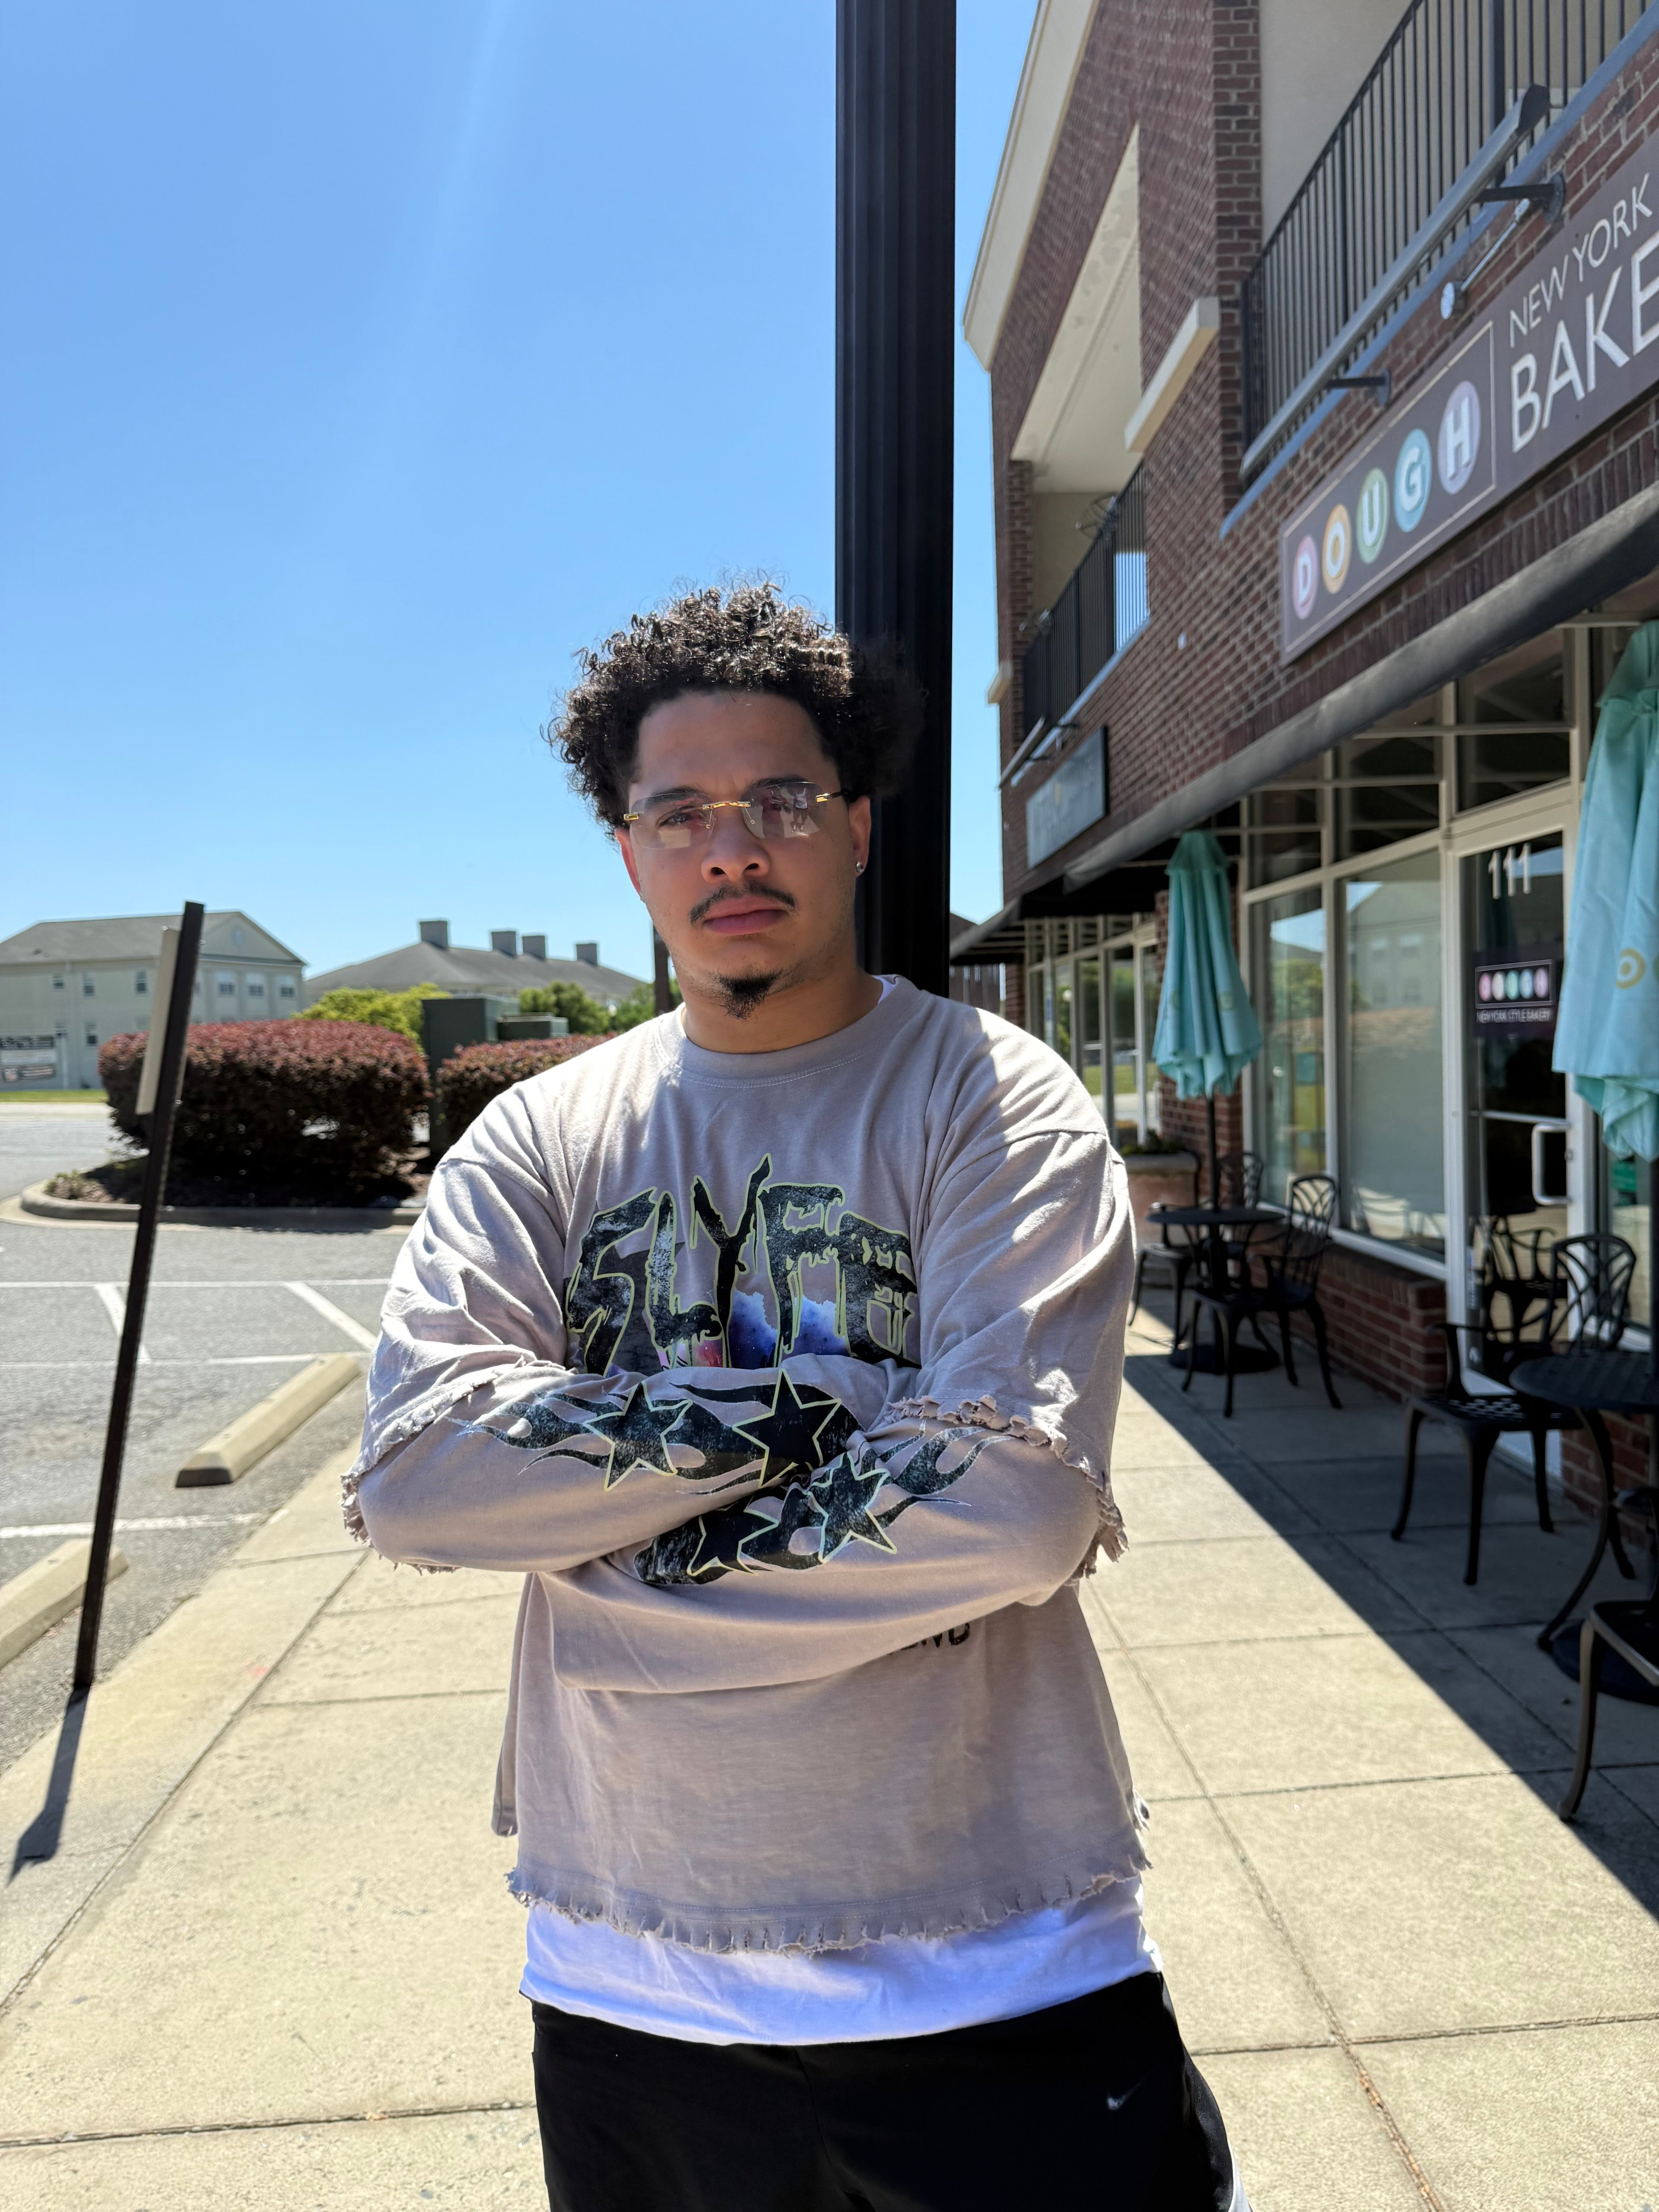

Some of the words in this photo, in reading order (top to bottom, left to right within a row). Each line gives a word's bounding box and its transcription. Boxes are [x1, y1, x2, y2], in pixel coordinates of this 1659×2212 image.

[1510, 254, 1569, 348] NEW
[1572, 173, 1653, 282] YORK
[1511, 230, 1659, 453] BAKE
[1296, 394, 1472, 607] DOUGH
[1488, 842, 1532, 899] 111
